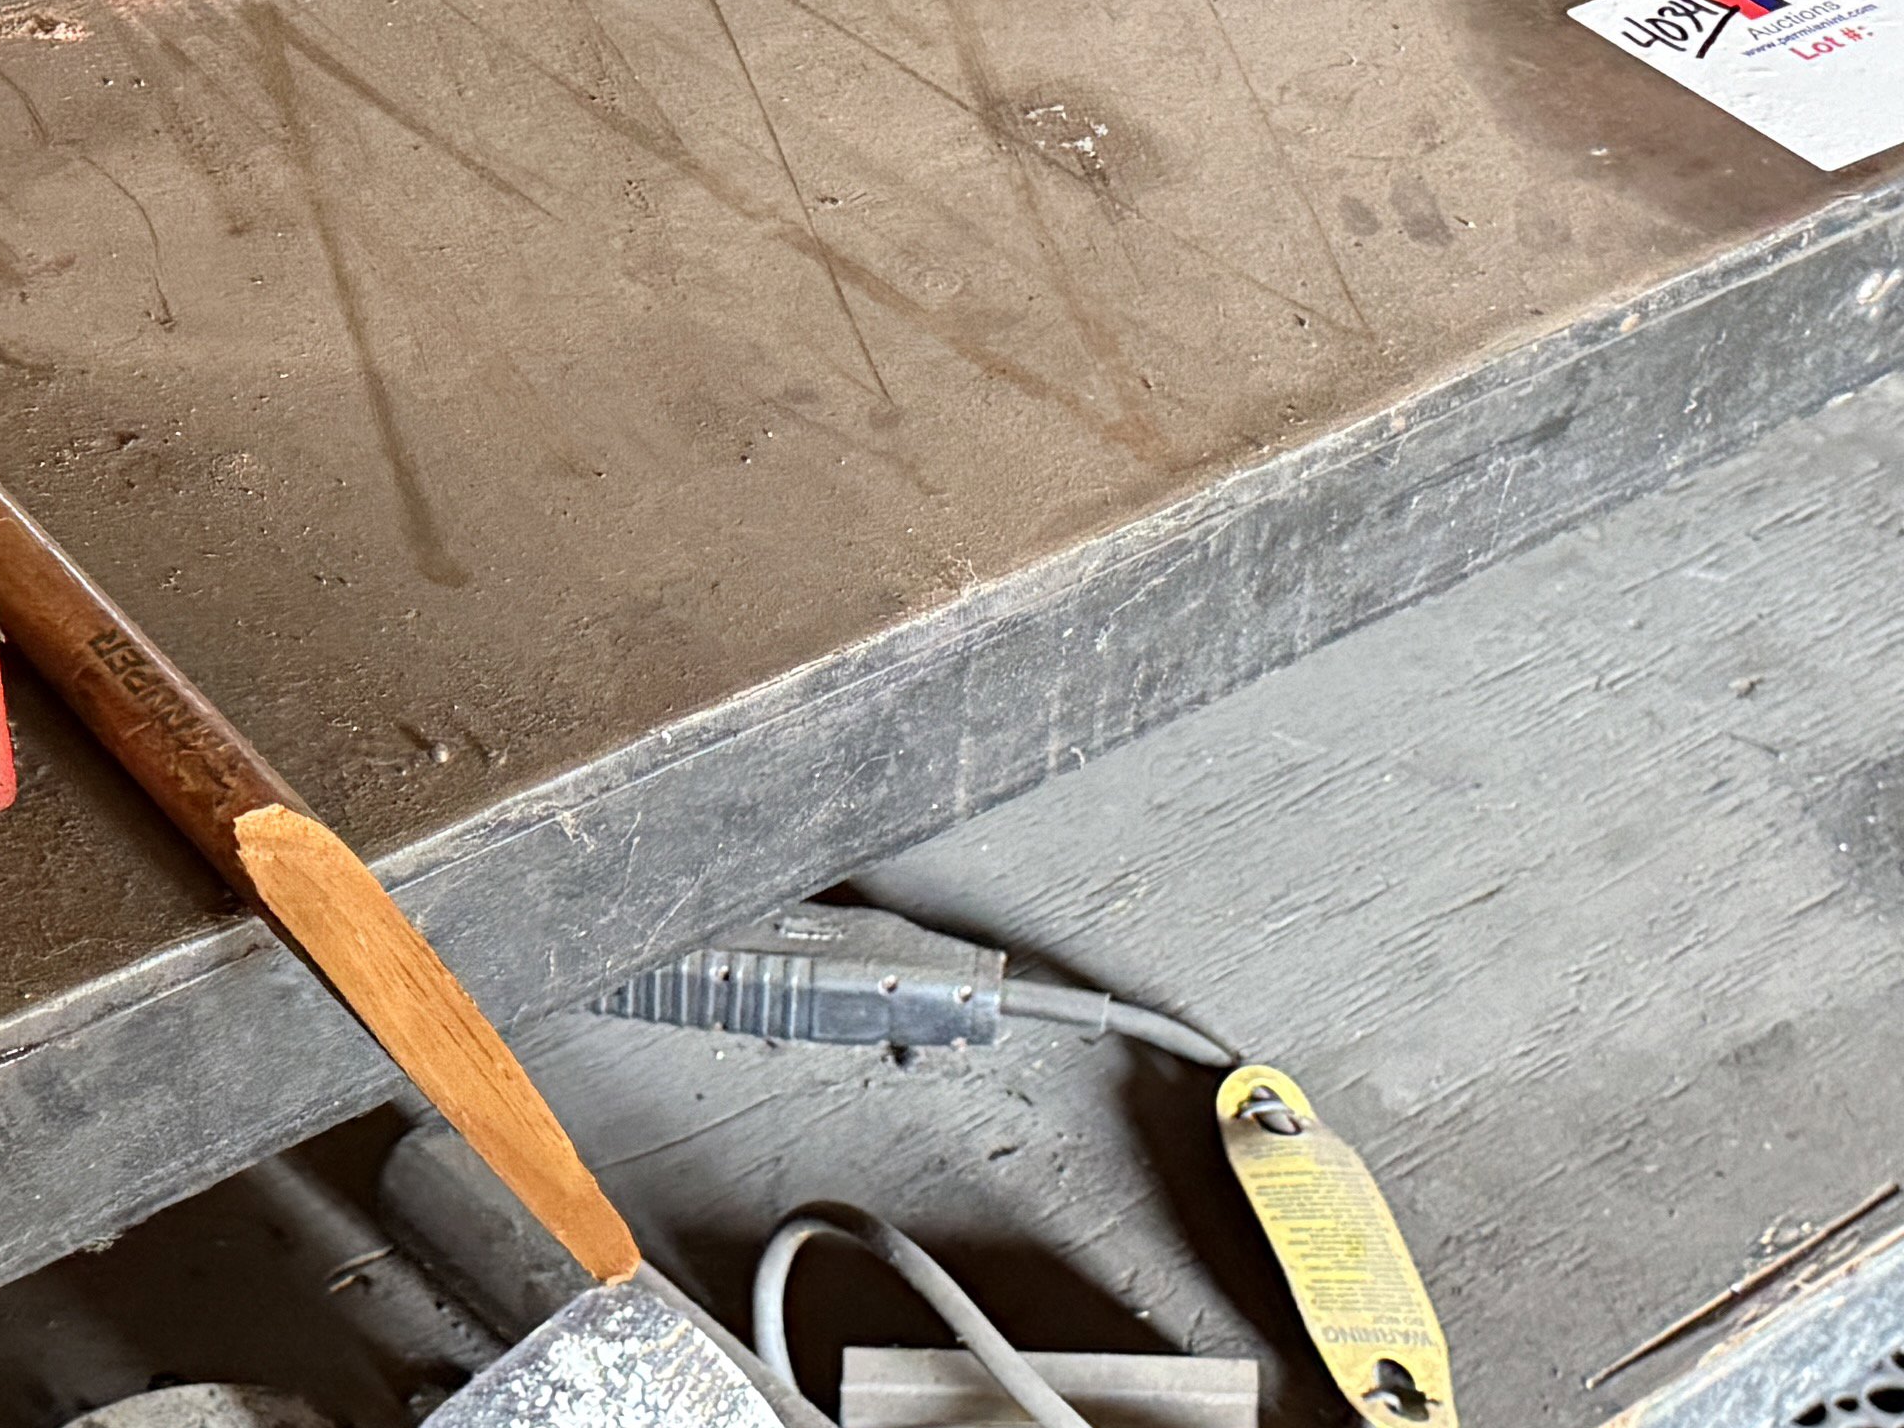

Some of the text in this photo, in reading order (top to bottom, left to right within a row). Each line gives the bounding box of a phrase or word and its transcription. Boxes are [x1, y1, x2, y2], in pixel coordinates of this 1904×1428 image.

[1742, 4, 1878, 56] www.permianint.com
[1747, 1, 1841, 41] Auctions
[1789, 36, 1846, 60] Lot
[1321, 1325, 1434, 1347] WARNING
